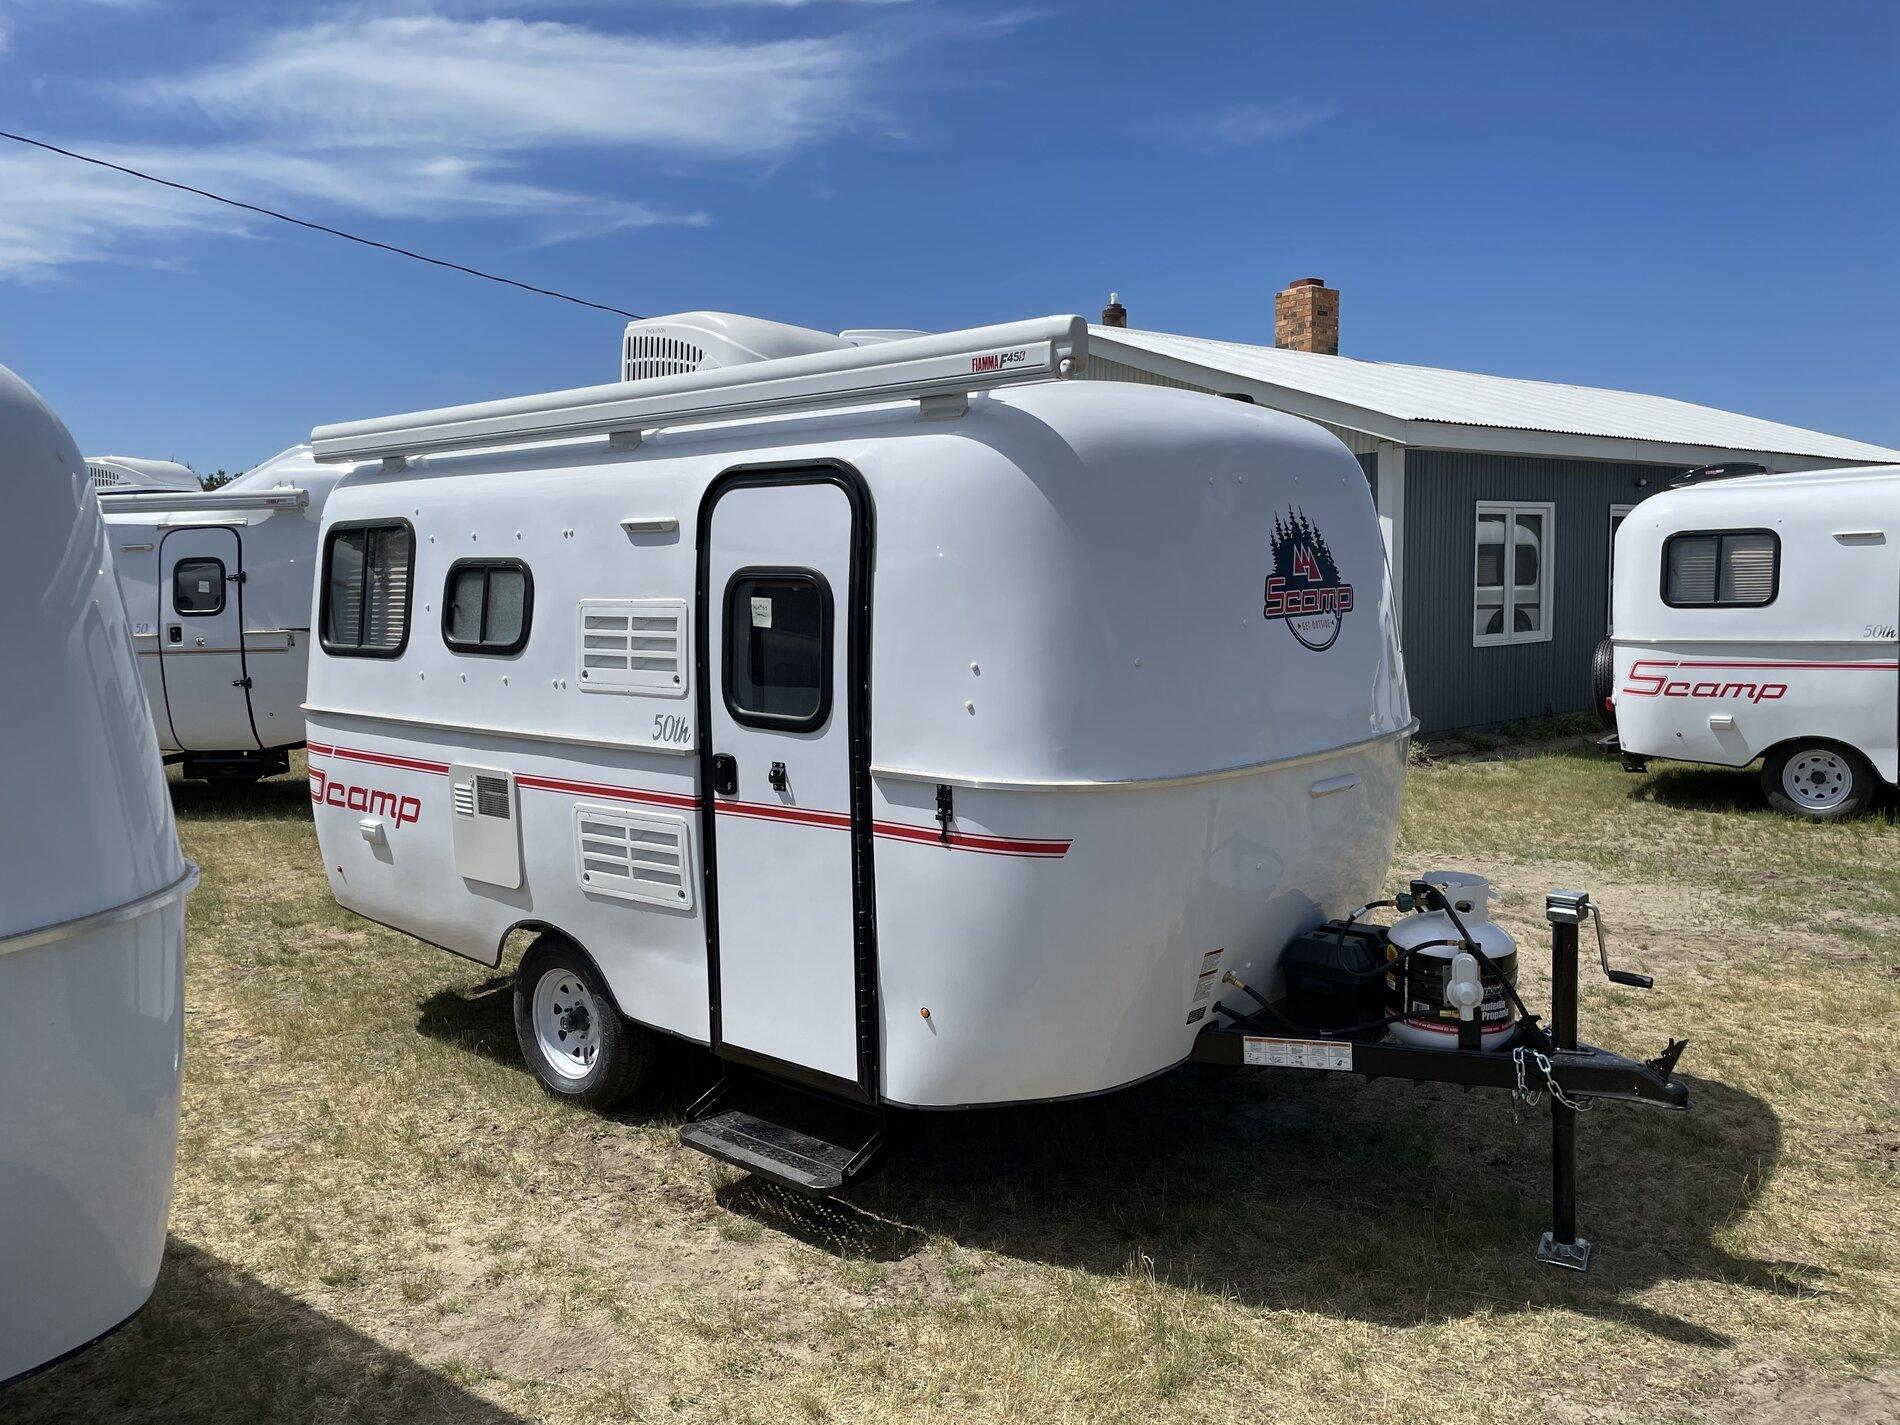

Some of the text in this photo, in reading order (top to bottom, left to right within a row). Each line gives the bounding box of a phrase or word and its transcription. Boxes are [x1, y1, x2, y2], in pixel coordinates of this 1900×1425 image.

[971, 355, 999, 373] FIAMMA
[1265, 576, 1353, 619] Scamp
[1863, 624, 1897, 639] 50th
[1622, 660, 1788, 704] Scamp
[652, 713, 691, 744] 50th
